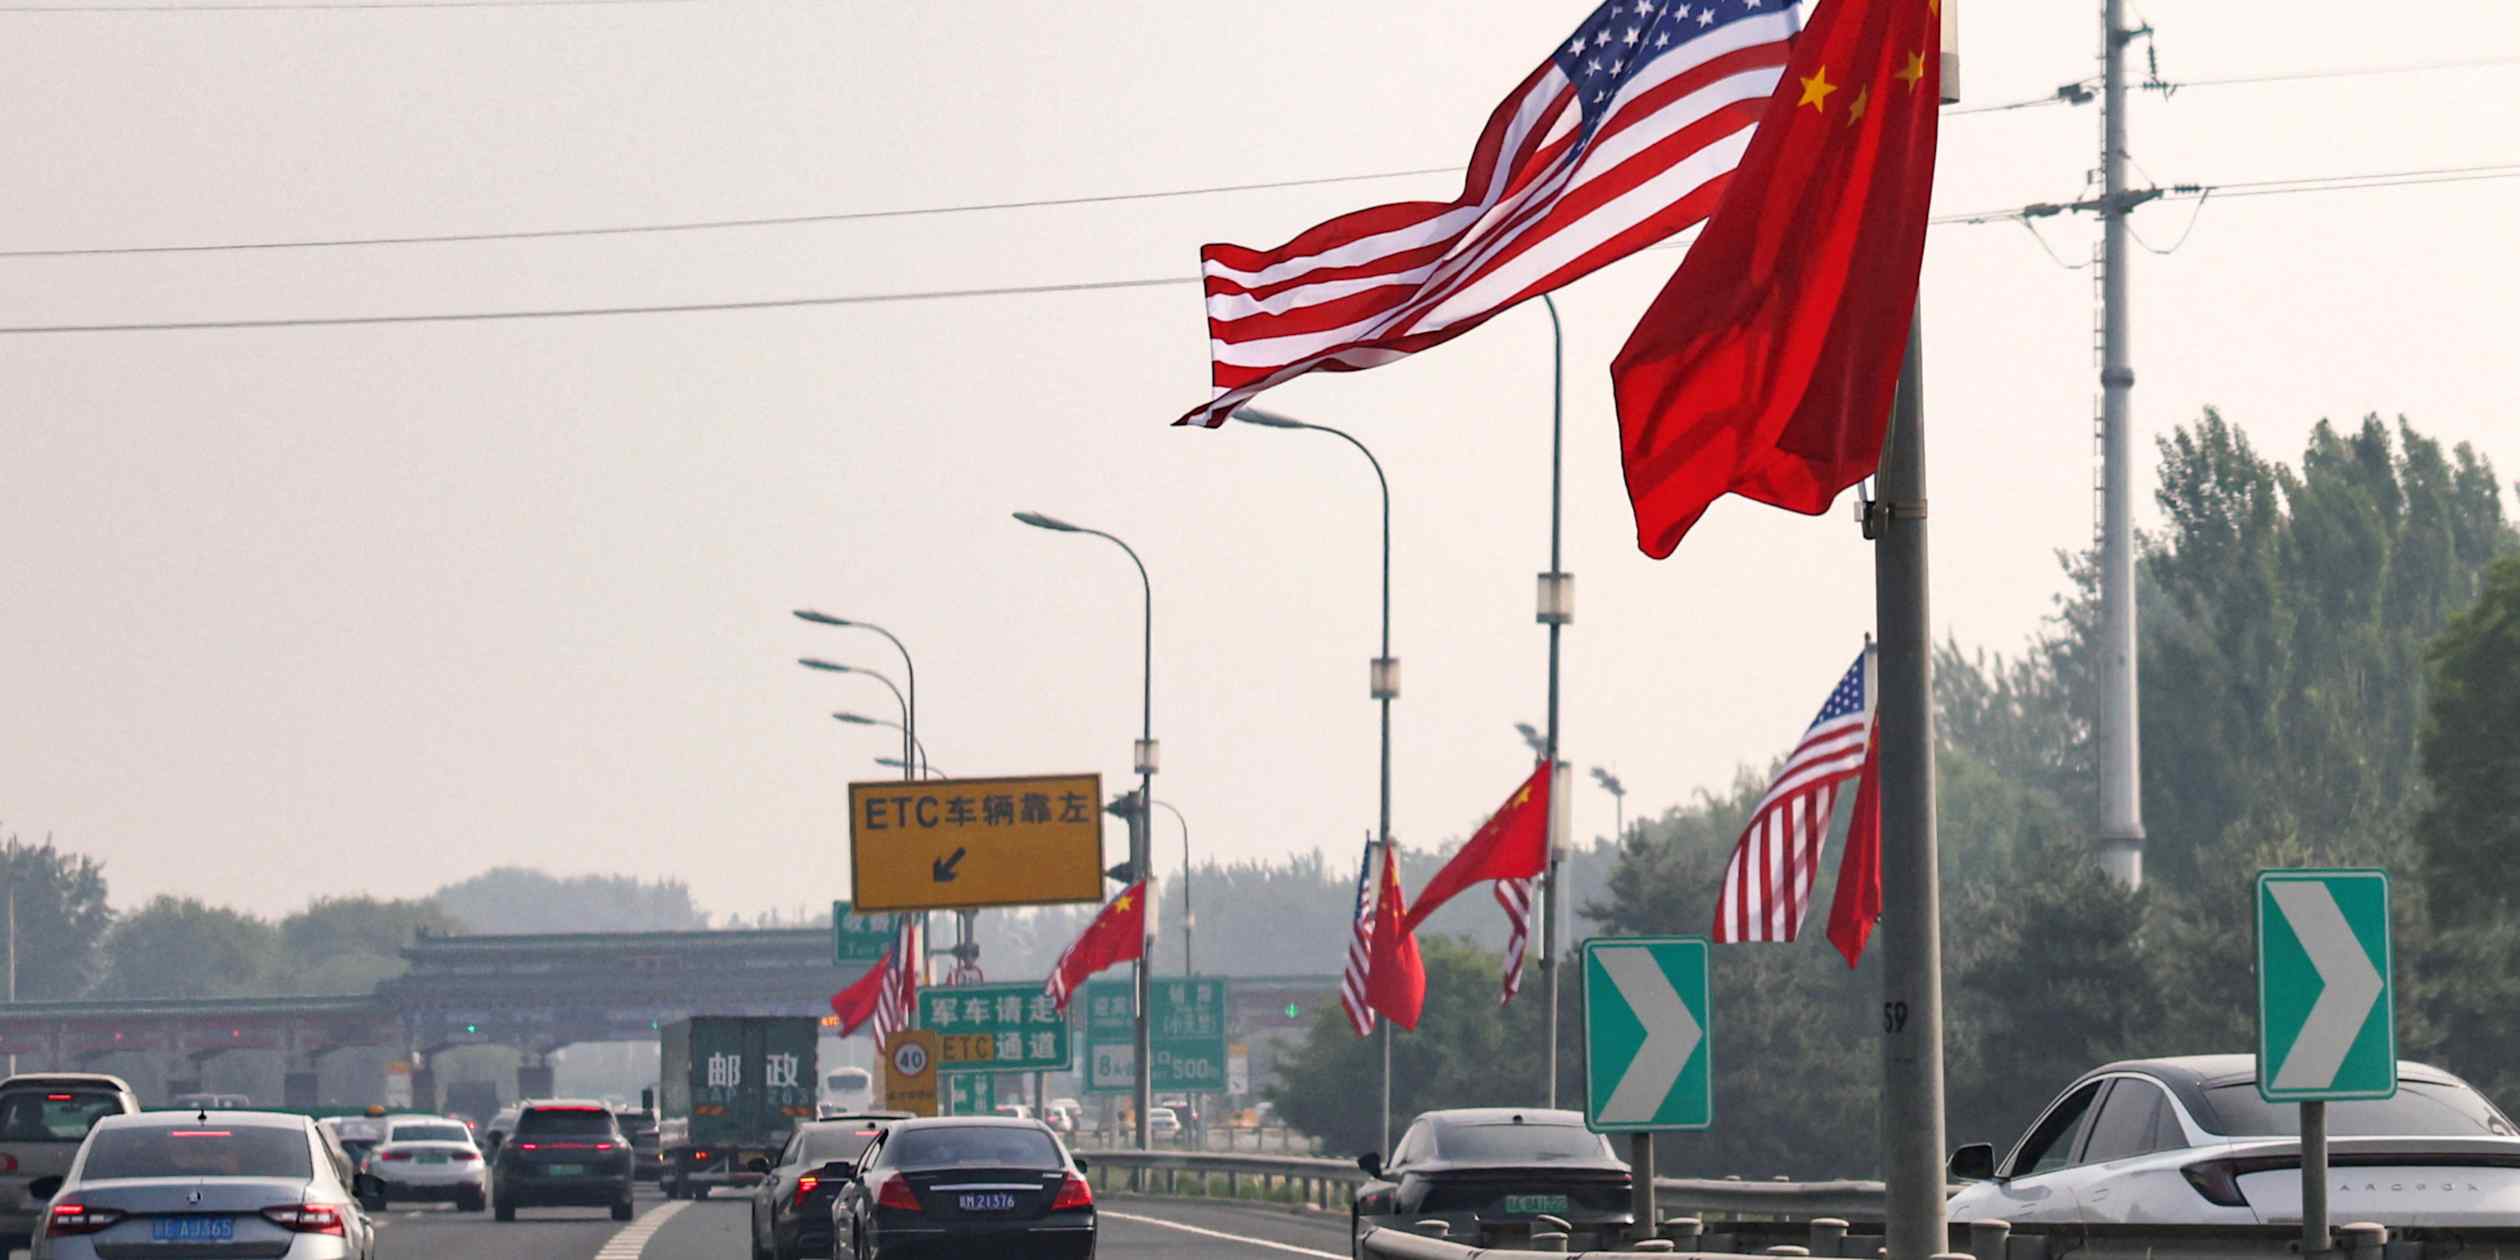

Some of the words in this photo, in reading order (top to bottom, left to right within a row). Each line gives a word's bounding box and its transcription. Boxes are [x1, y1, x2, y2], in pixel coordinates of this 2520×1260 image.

[864, 791, 1089, 830] ETC车辆靠左
[931, 995, 1056, 1027] 军车请走
[1883, 1001, 1908, 1035] 59
[900, 1051, 923, 1064] 40
[943, 1032, 1057, 1063] ETC通道
[708, 1051, 799, 1087] 邮政
